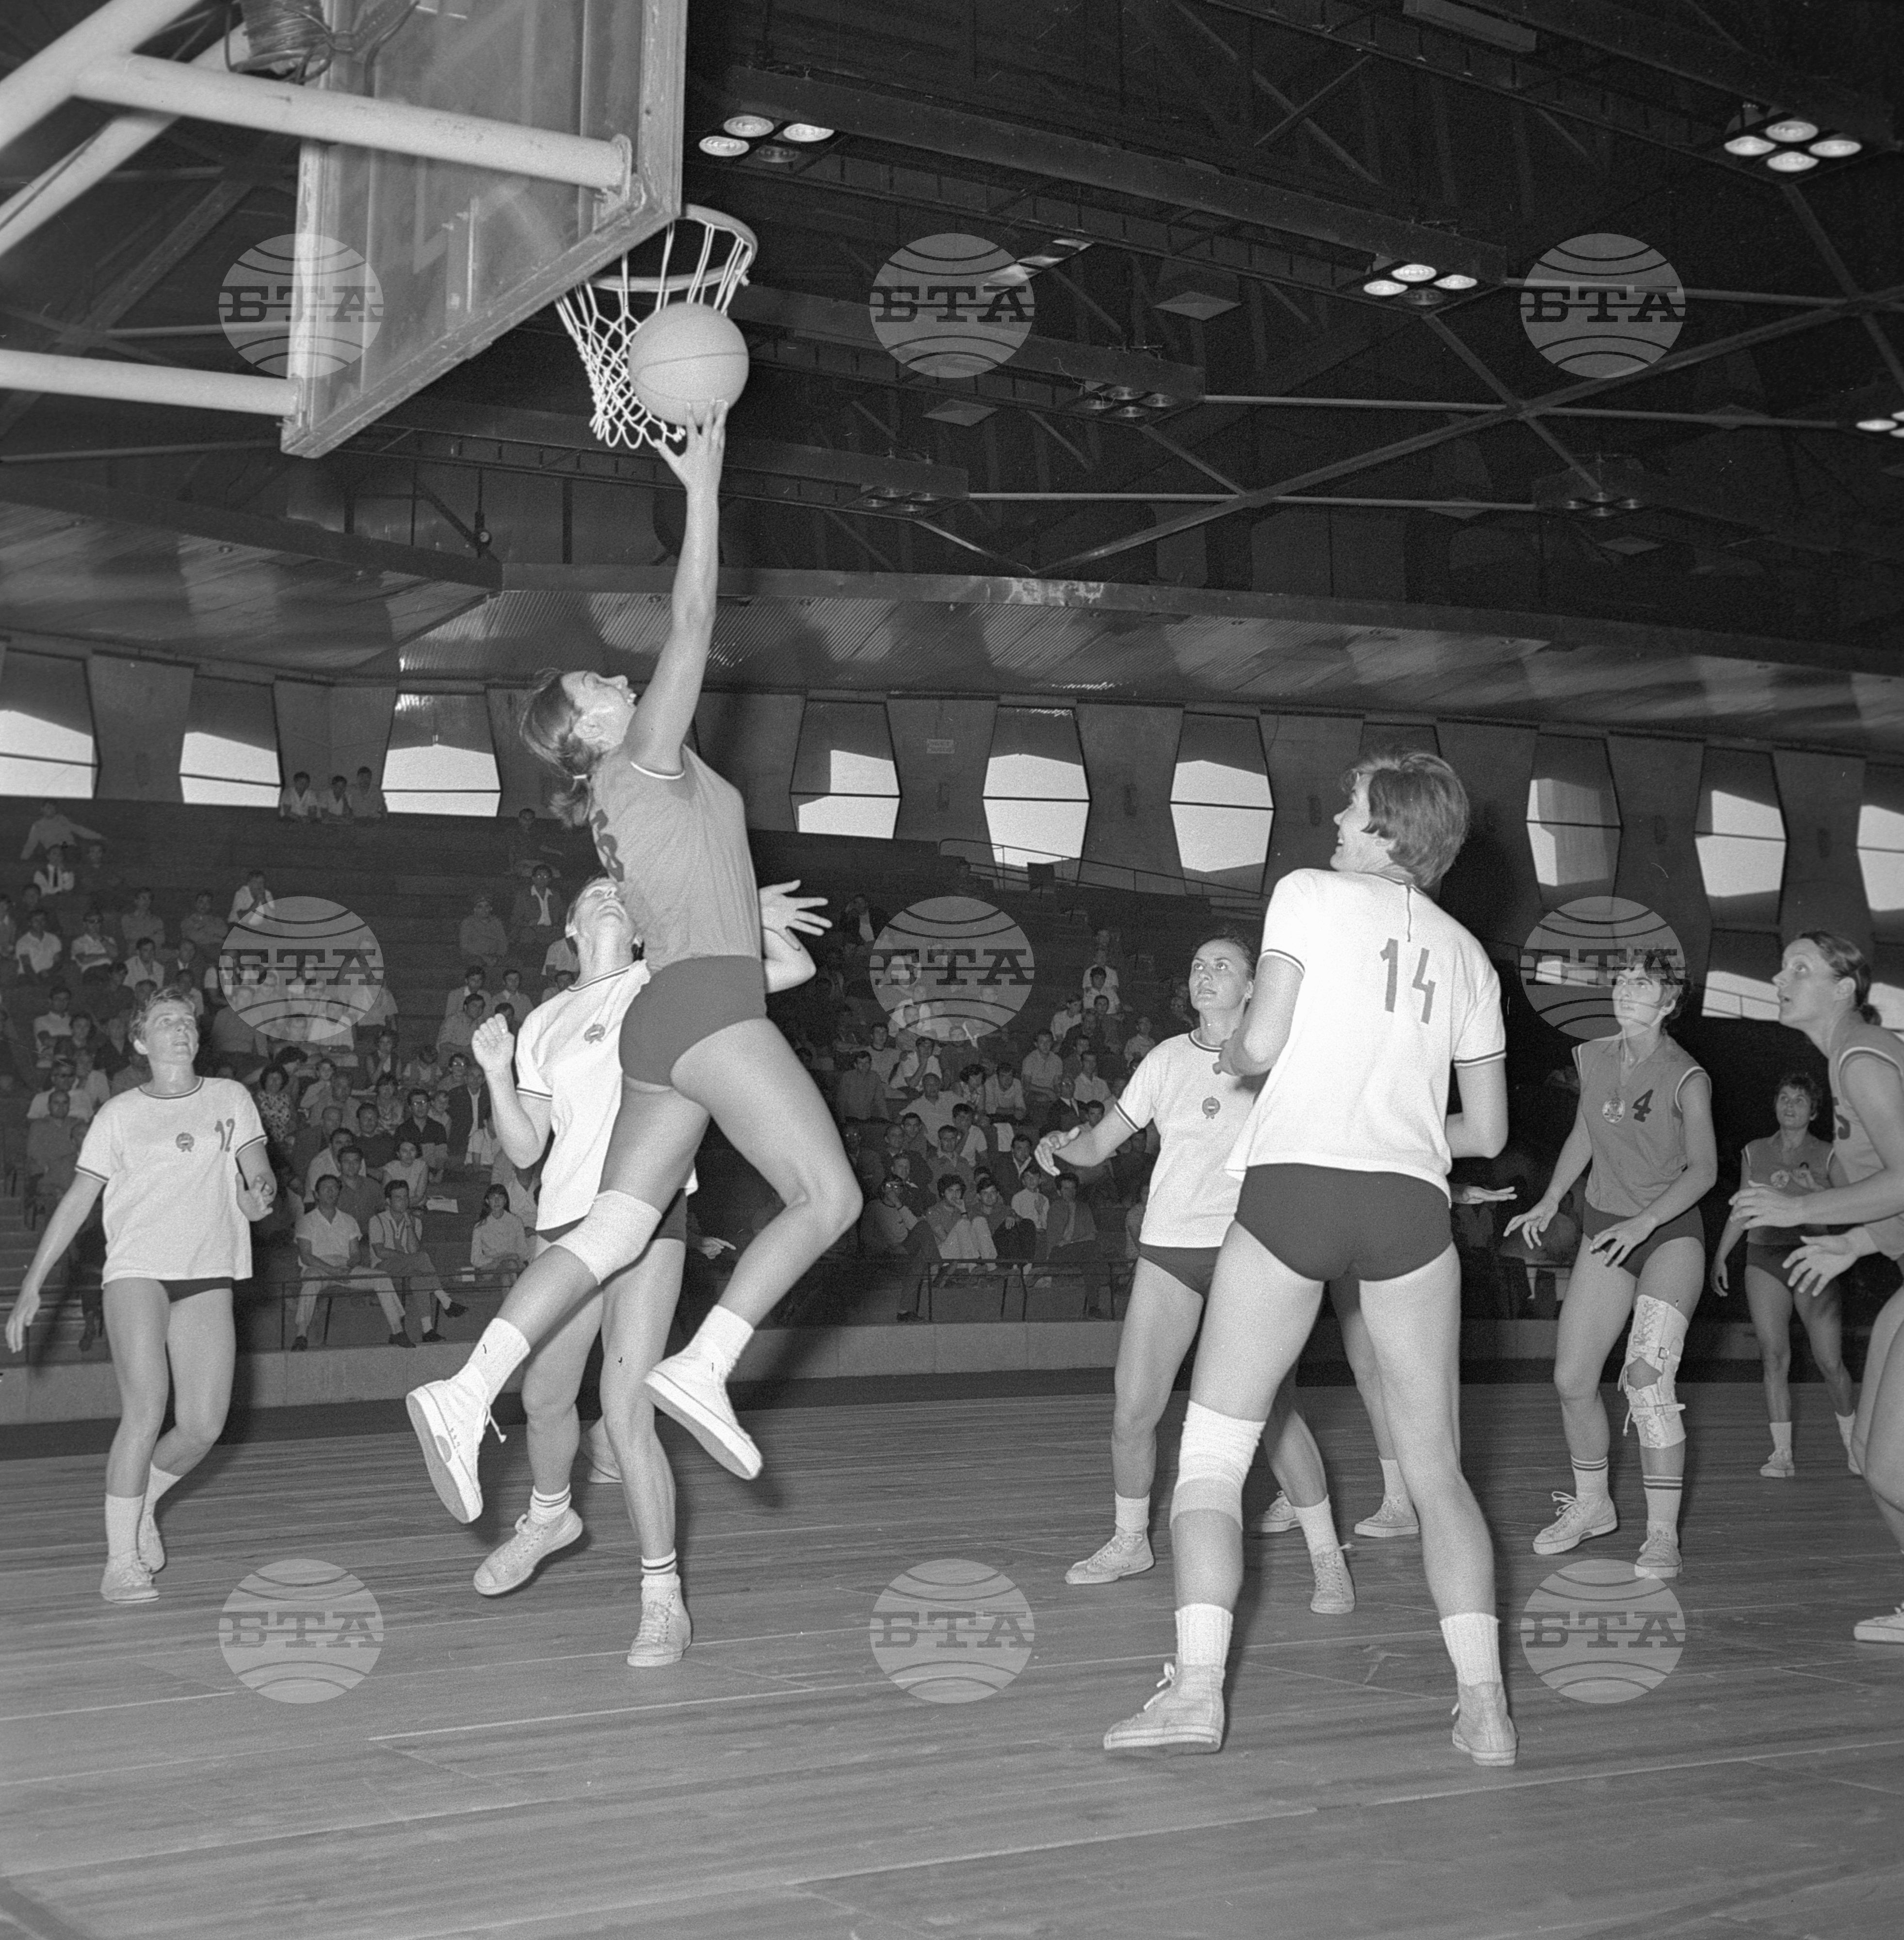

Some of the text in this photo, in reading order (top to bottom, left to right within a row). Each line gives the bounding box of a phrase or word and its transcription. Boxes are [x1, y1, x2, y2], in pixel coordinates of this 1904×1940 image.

[1380, 938, 1436, 1024] 14
[1632, 1089, 1654, 1122] 4
[214, 1118, 235, 1152] 12
